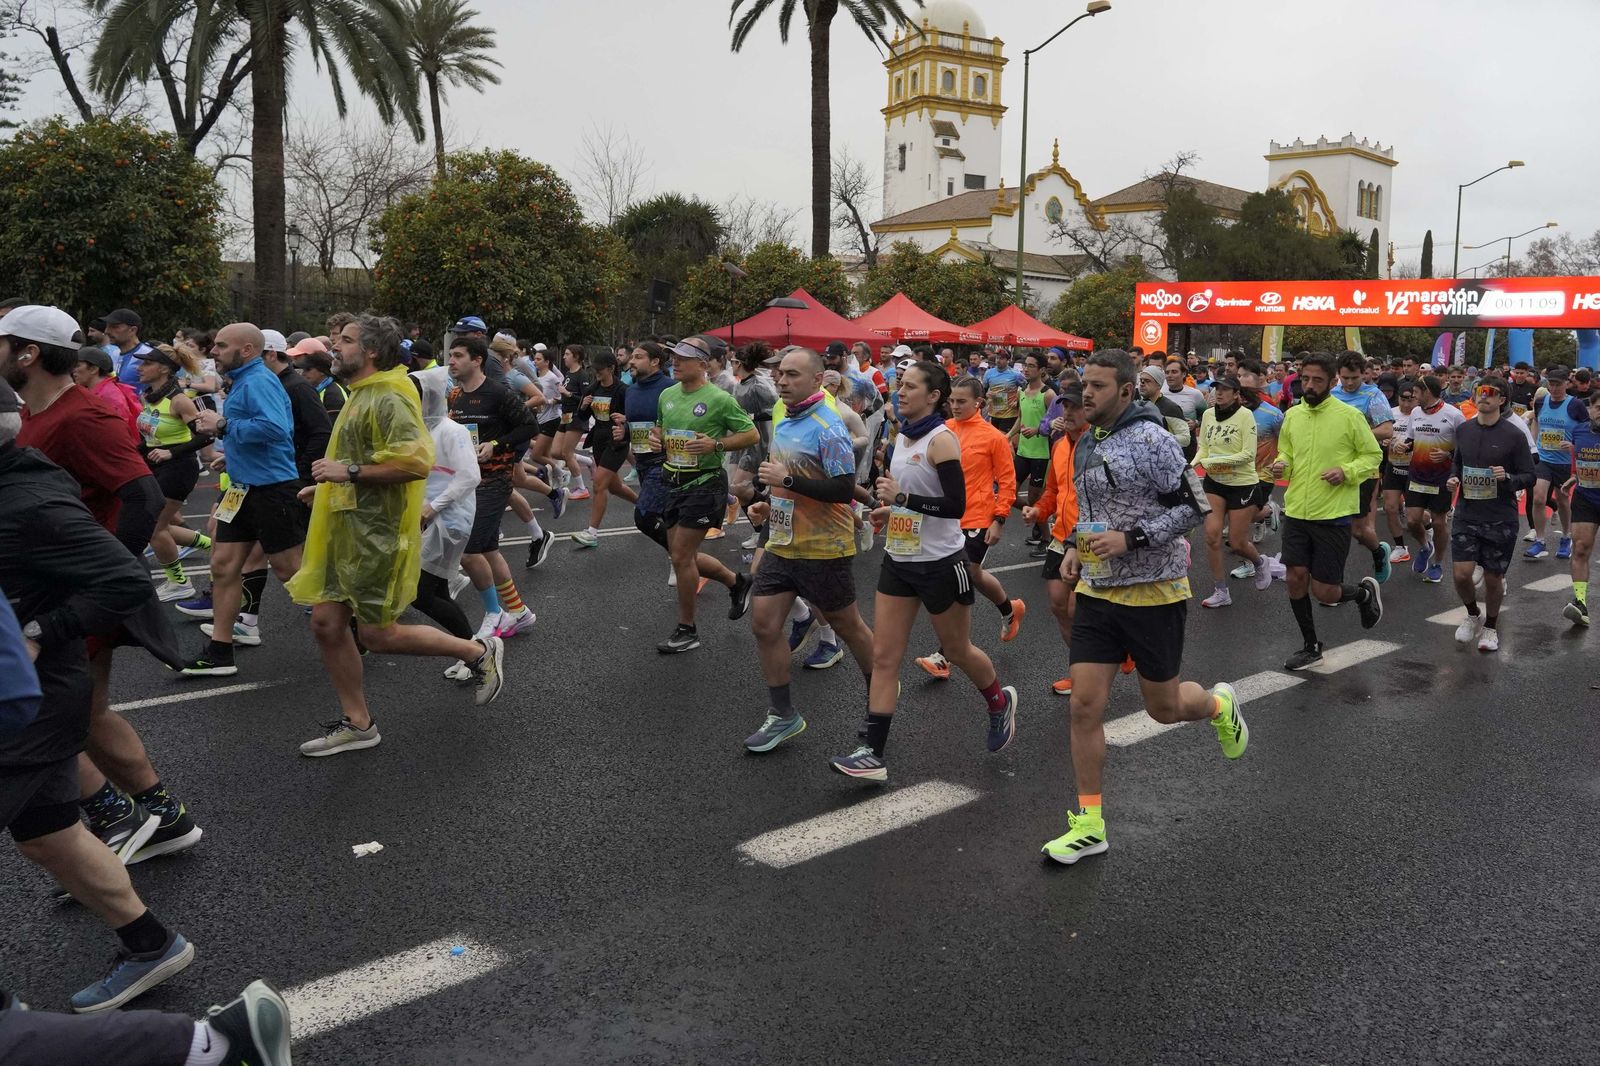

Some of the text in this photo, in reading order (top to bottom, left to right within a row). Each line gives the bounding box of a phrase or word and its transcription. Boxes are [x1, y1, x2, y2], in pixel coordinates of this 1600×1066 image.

[1404, 288, 1479, 303] maratón
[1215, 297, 1253, 308] Sprinter
[1292, 296, 1336, 311] HOKA
[1421, 302, 1478, 315] sevilla
[1464, 475, 1491, 486] 20020
